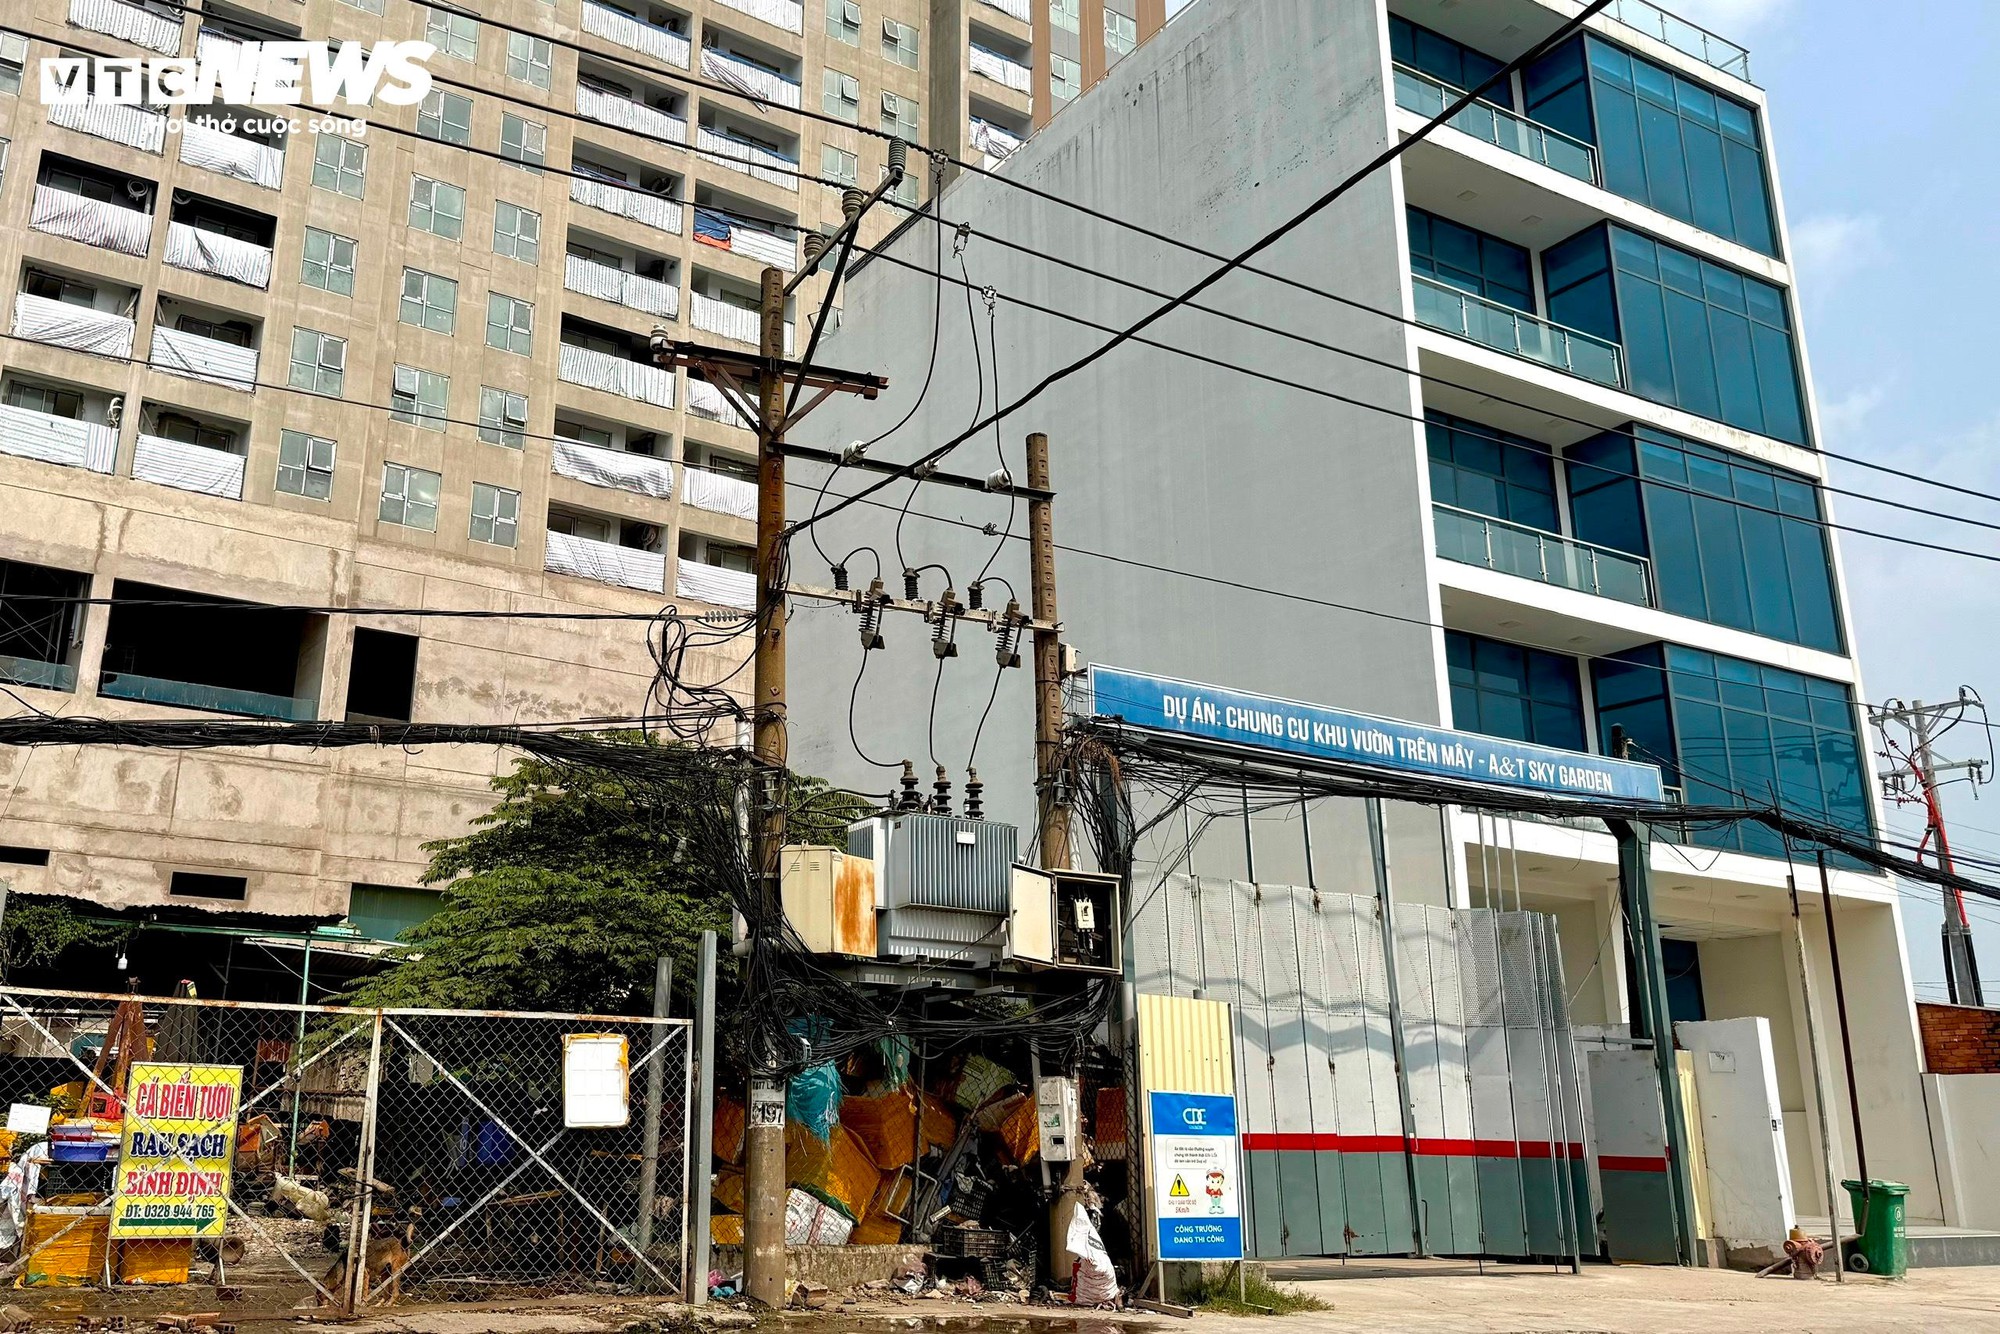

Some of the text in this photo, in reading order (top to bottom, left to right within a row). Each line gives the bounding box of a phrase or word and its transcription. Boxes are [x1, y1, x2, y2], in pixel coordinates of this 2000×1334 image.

[1163, 695, 1188, 724] DỰ
[1191, 697, 1221, 726] ÁN:
[1226, 706, 1283, 736] CHUNG
[1287, 717, 1310, 741] CƯ
[1313, 722, 1348, 748] KHU
[1350, 726, 1394, 757] VƯỜN
[1397, 736, 1438, 763] TRÊN
[1441, 742, 1474, 769] MÂY
[1489, 753, 1525, 779] A&T
[1529, 758, 1556, 784] SKY
[1559, 764, 1613, 792] GARDEN
[130, 1132, 174, 1158] RAU
[125, 1204, 215, 1218] ĐT: 0328 944 765
[1174, 1224, 1194, 1233] CÔNG
[1174, 1236, 1193, 1244] ĐANG
[1206, 1234, 1225, 1243] CÔNG
